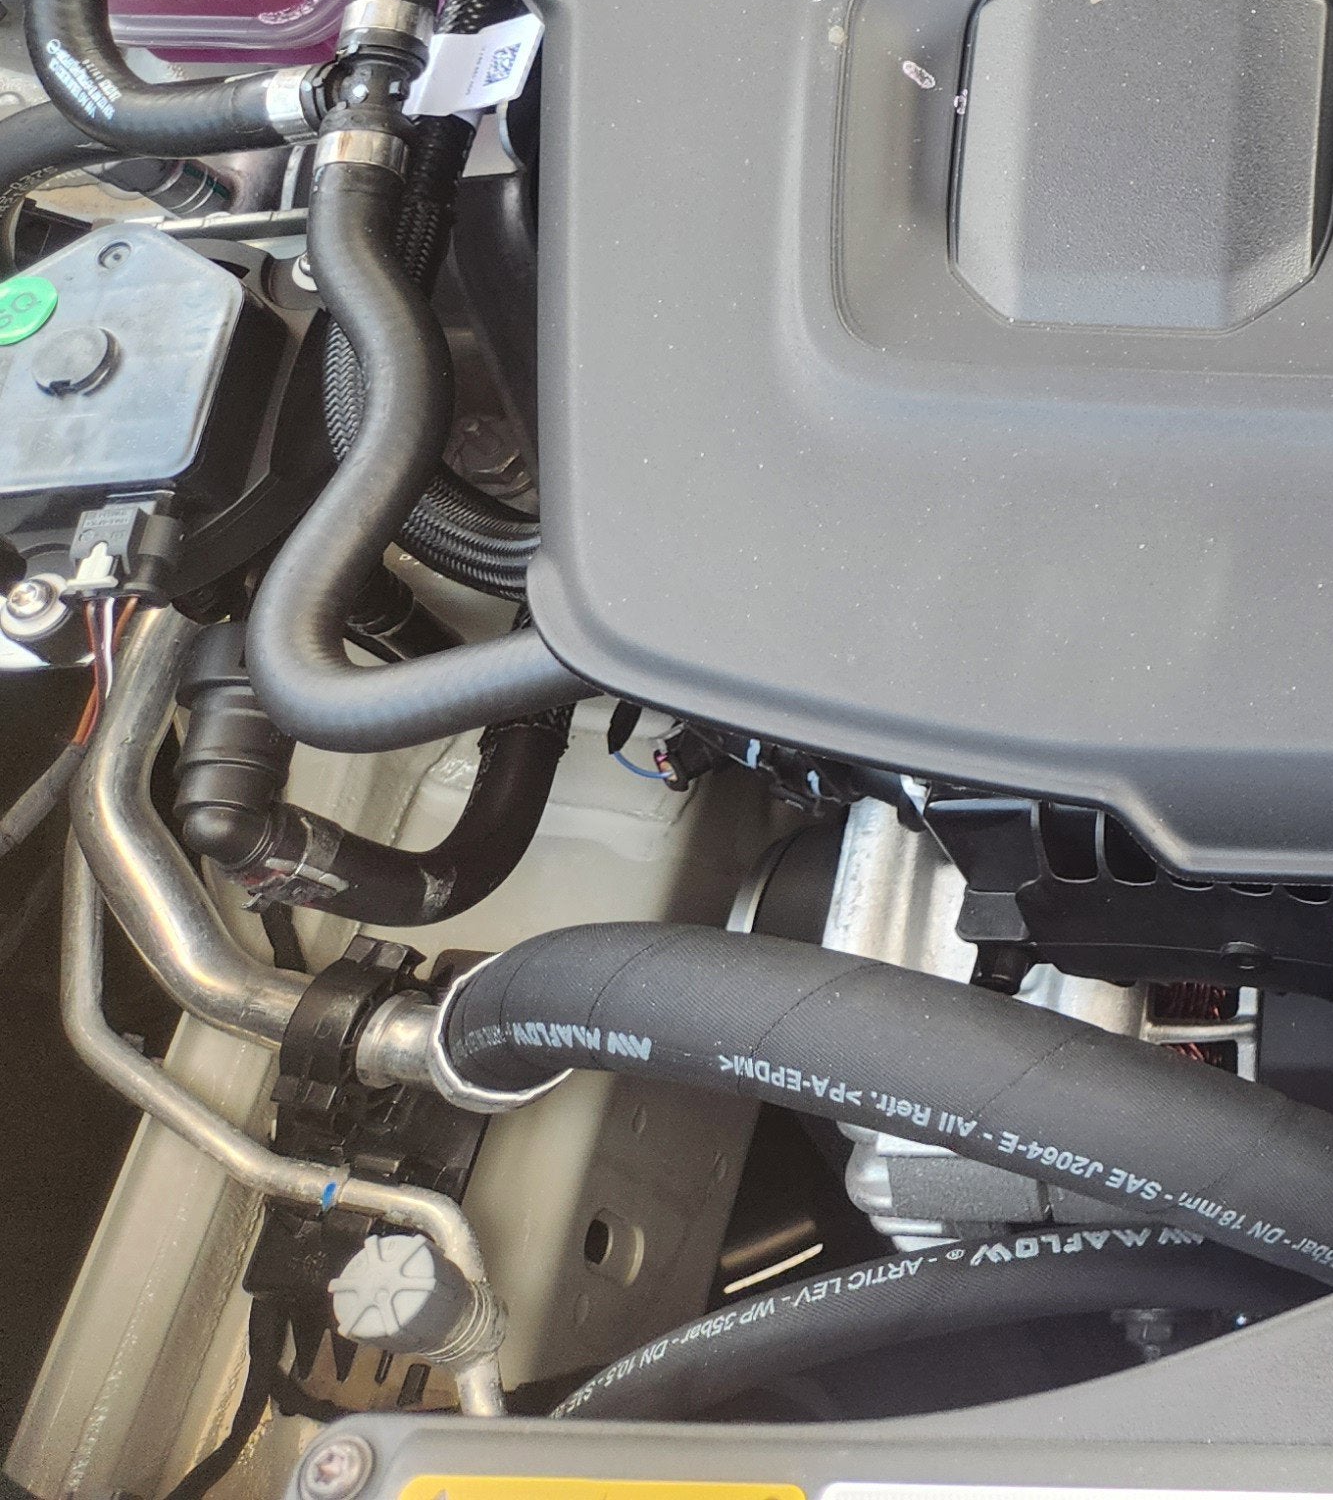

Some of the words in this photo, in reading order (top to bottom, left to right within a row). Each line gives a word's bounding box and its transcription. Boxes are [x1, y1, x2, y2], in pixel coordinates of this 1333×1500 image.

[870, 1090, 931, 1128] Refr.
[997, 1130, 1104, 1179] J2064-E
[1105, 1167, 1162, 1200] SAE
[969, 1227, 1151, 1267] MAFLOW
[1247, 1220, 1286, 1245] DN
[847, 1256, 924, 1290] ARTIC
[793, 1277, 842, 1308] LEV
[740, 1297, 776, 1325] WP
[680, 1311, 737, 1345] 35bar
[639, 1339, 669, 1369] DN
